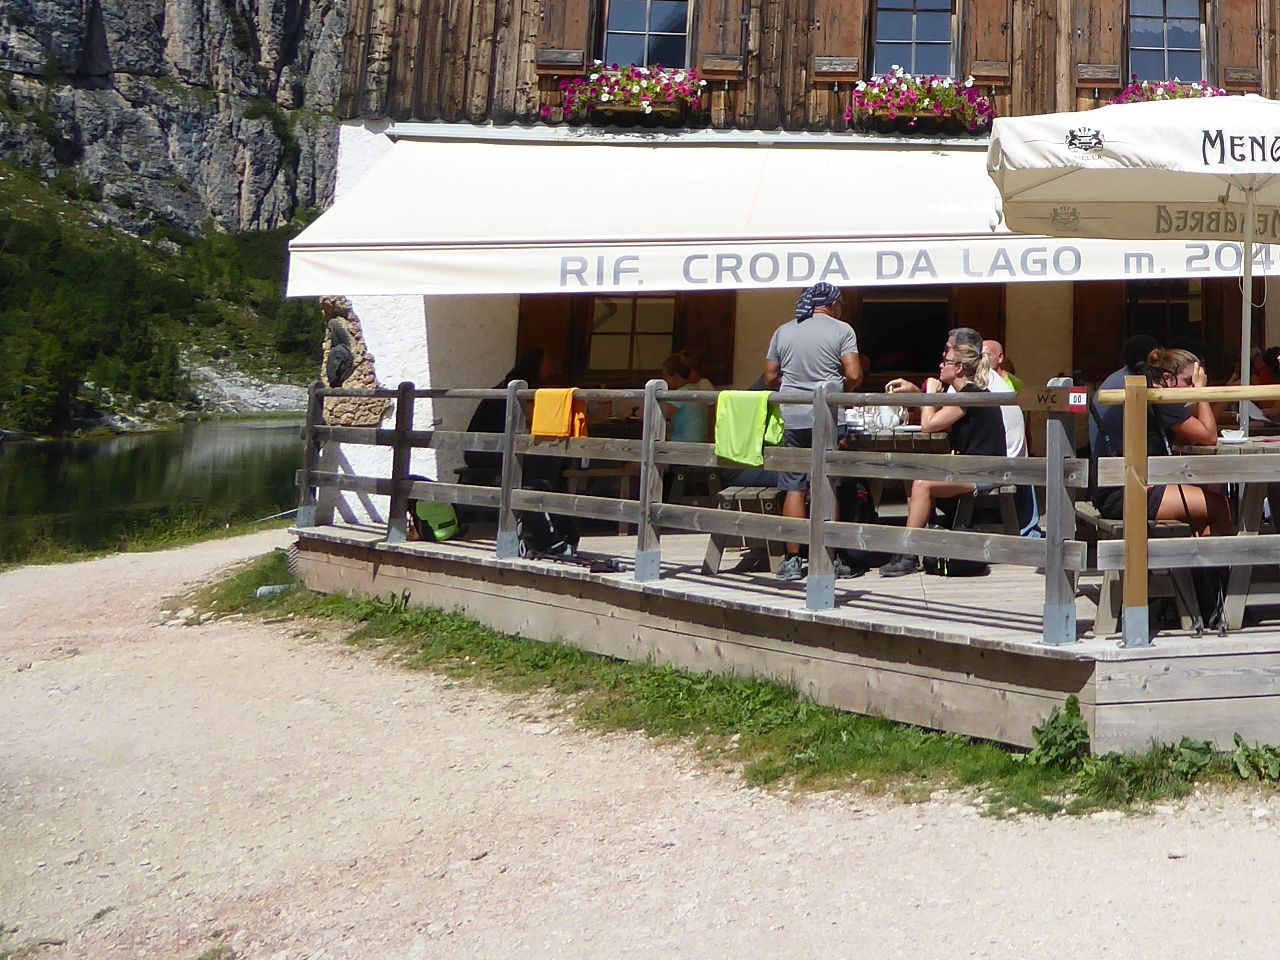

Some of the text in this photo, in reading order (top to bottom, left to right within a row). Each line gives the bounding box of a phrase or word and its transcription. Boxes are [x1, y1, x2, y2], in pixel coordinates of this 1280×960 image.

[559, 254, 644, 287] RIF.
[682, 250, 850, 284] CRODA
[876, 249, 938, 280] DA
[962, 245, 1082, 278] LAGO
[1037, 393, 1057, 404] WC
